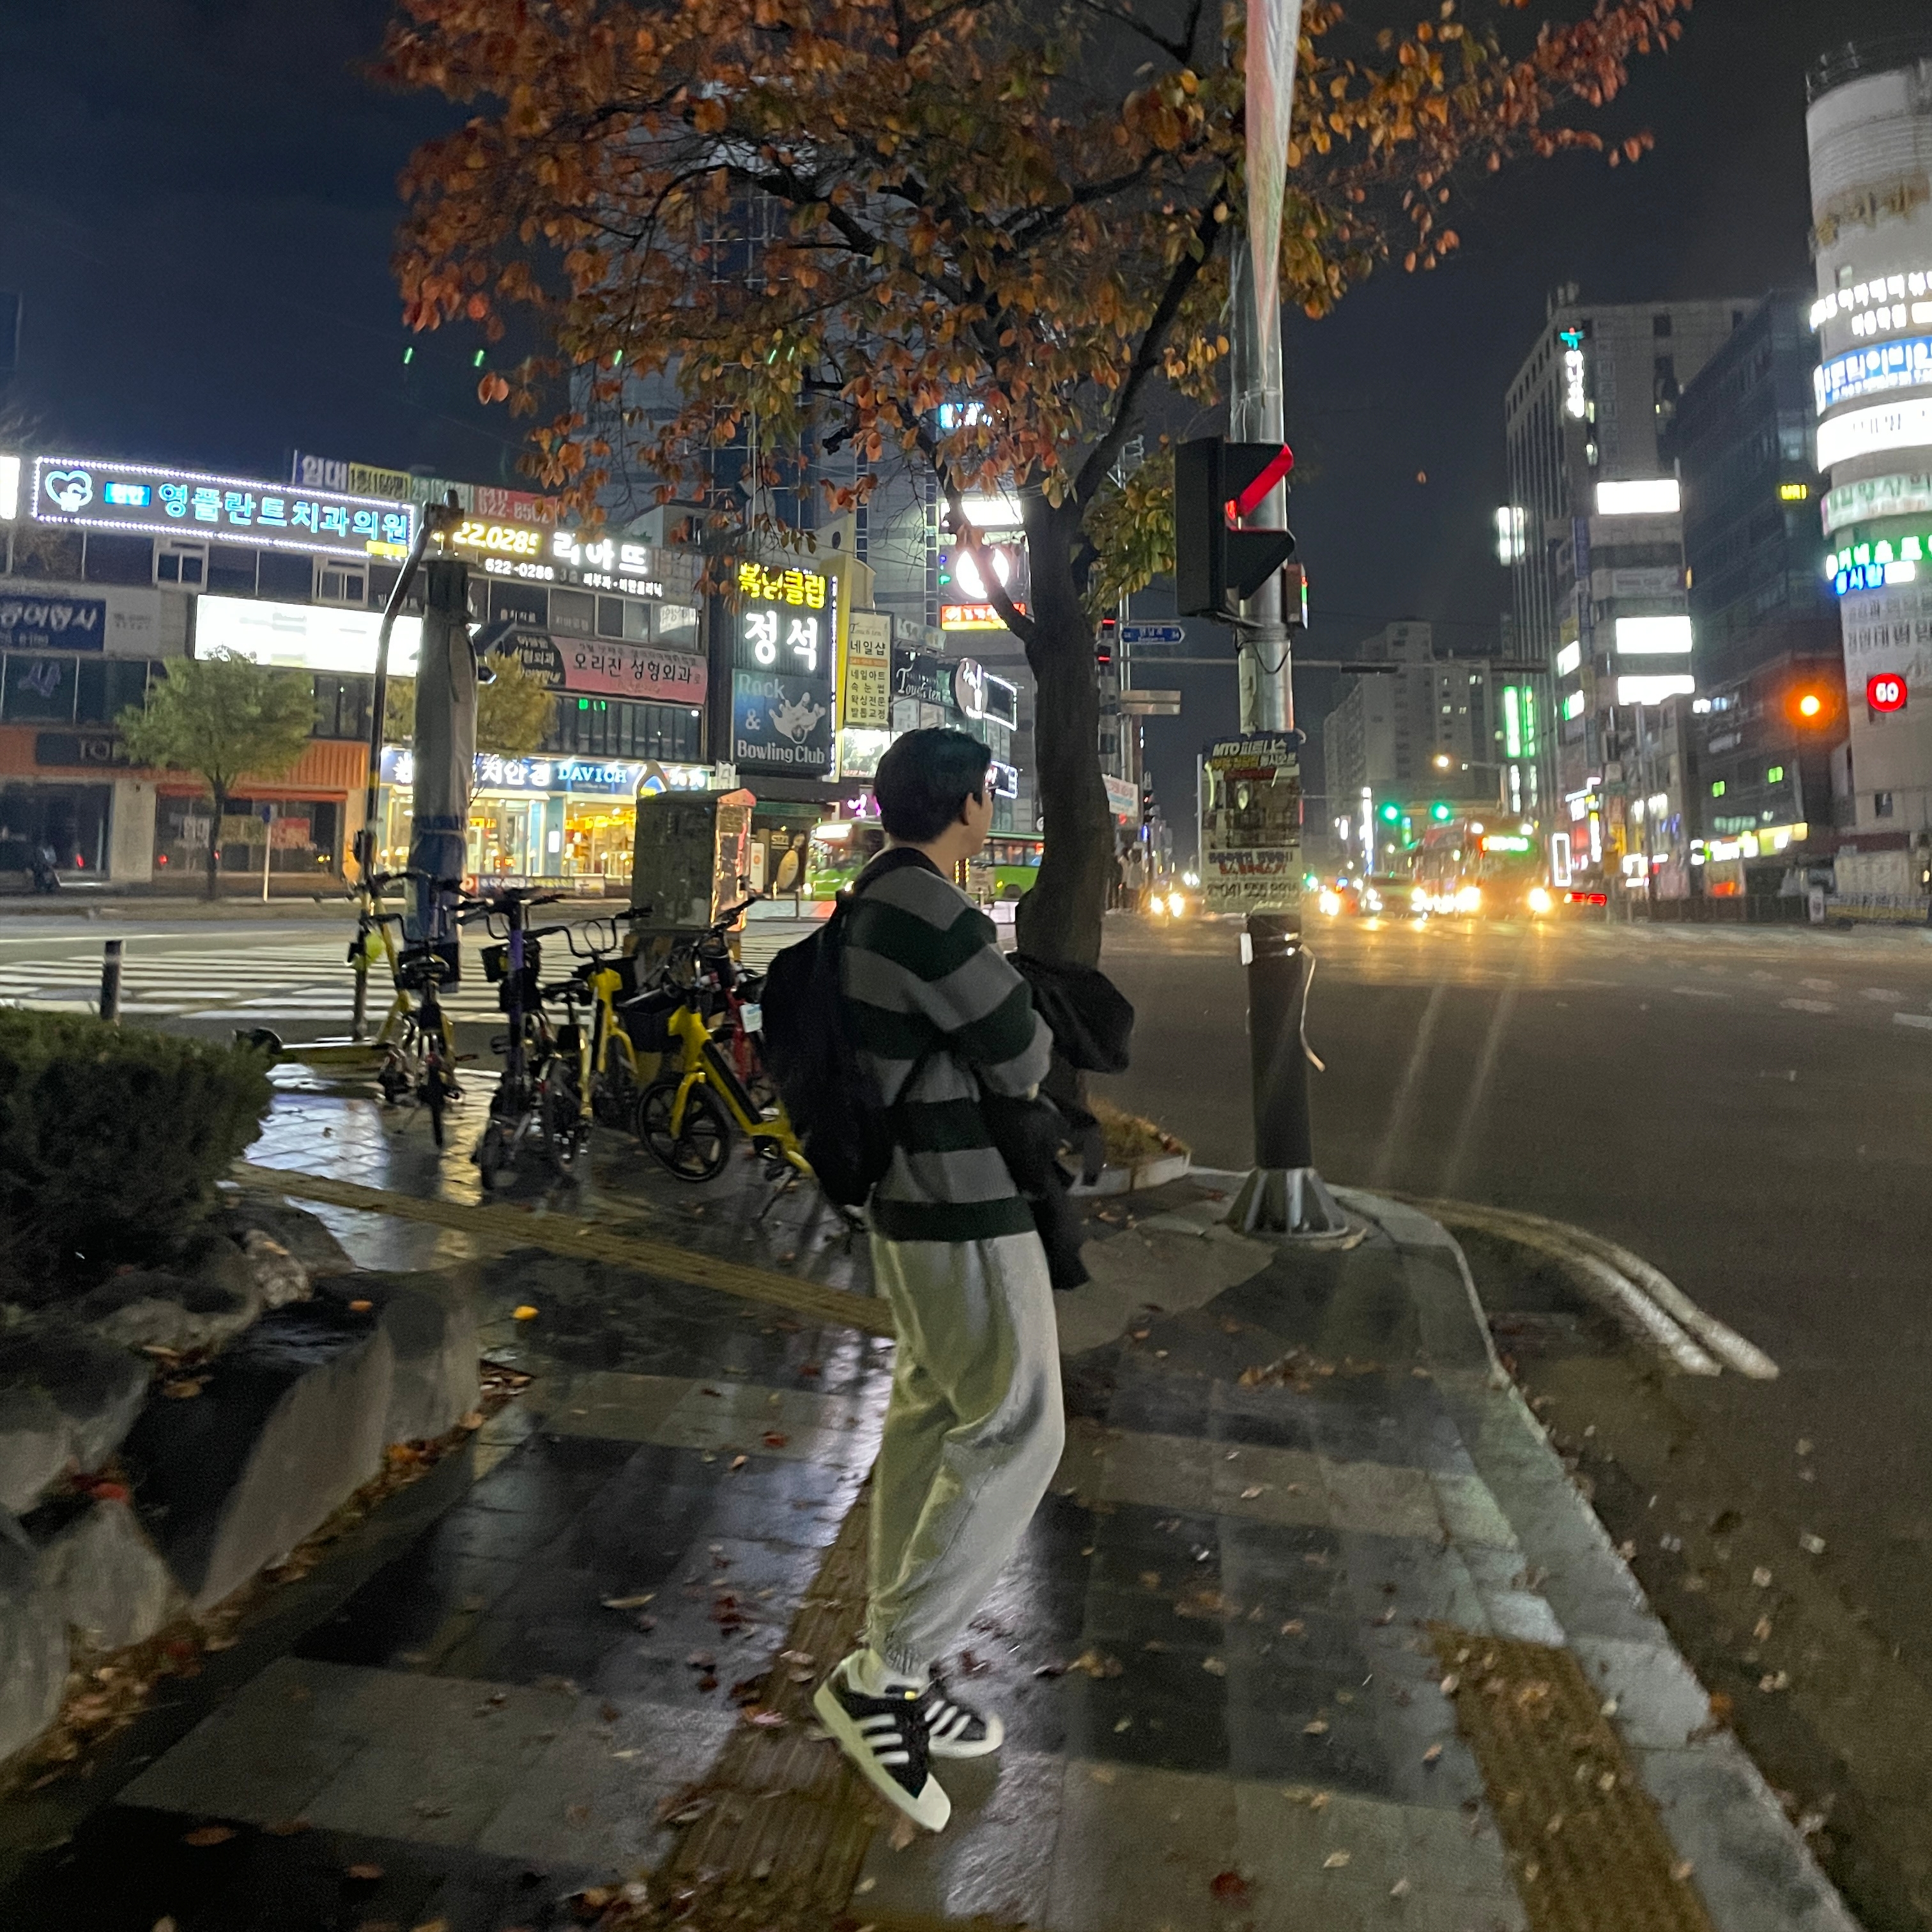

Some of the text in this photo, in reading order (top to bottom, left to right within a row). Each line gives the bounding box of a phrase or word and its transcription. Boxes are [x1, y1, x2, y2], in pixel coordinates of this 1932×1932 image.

[158, 482, 408, 544] 영플란트치과의원
[744, 610, 818, 671] 정석
[850, 640, 885, 656] 네일샵
[575, 654, 622, 677] 오리진
[631, 659, 691, 684] 성형외과
[851, 670, 885, 681] 네일아트
[739, 673, 785, 700] Rock
[851, 694, 885, 707] 왁싱전문
[745, 708, 762, 730] &
[737, 739, 825, 764] Bowling Club
[473, 755, 551, 786] 치안경
